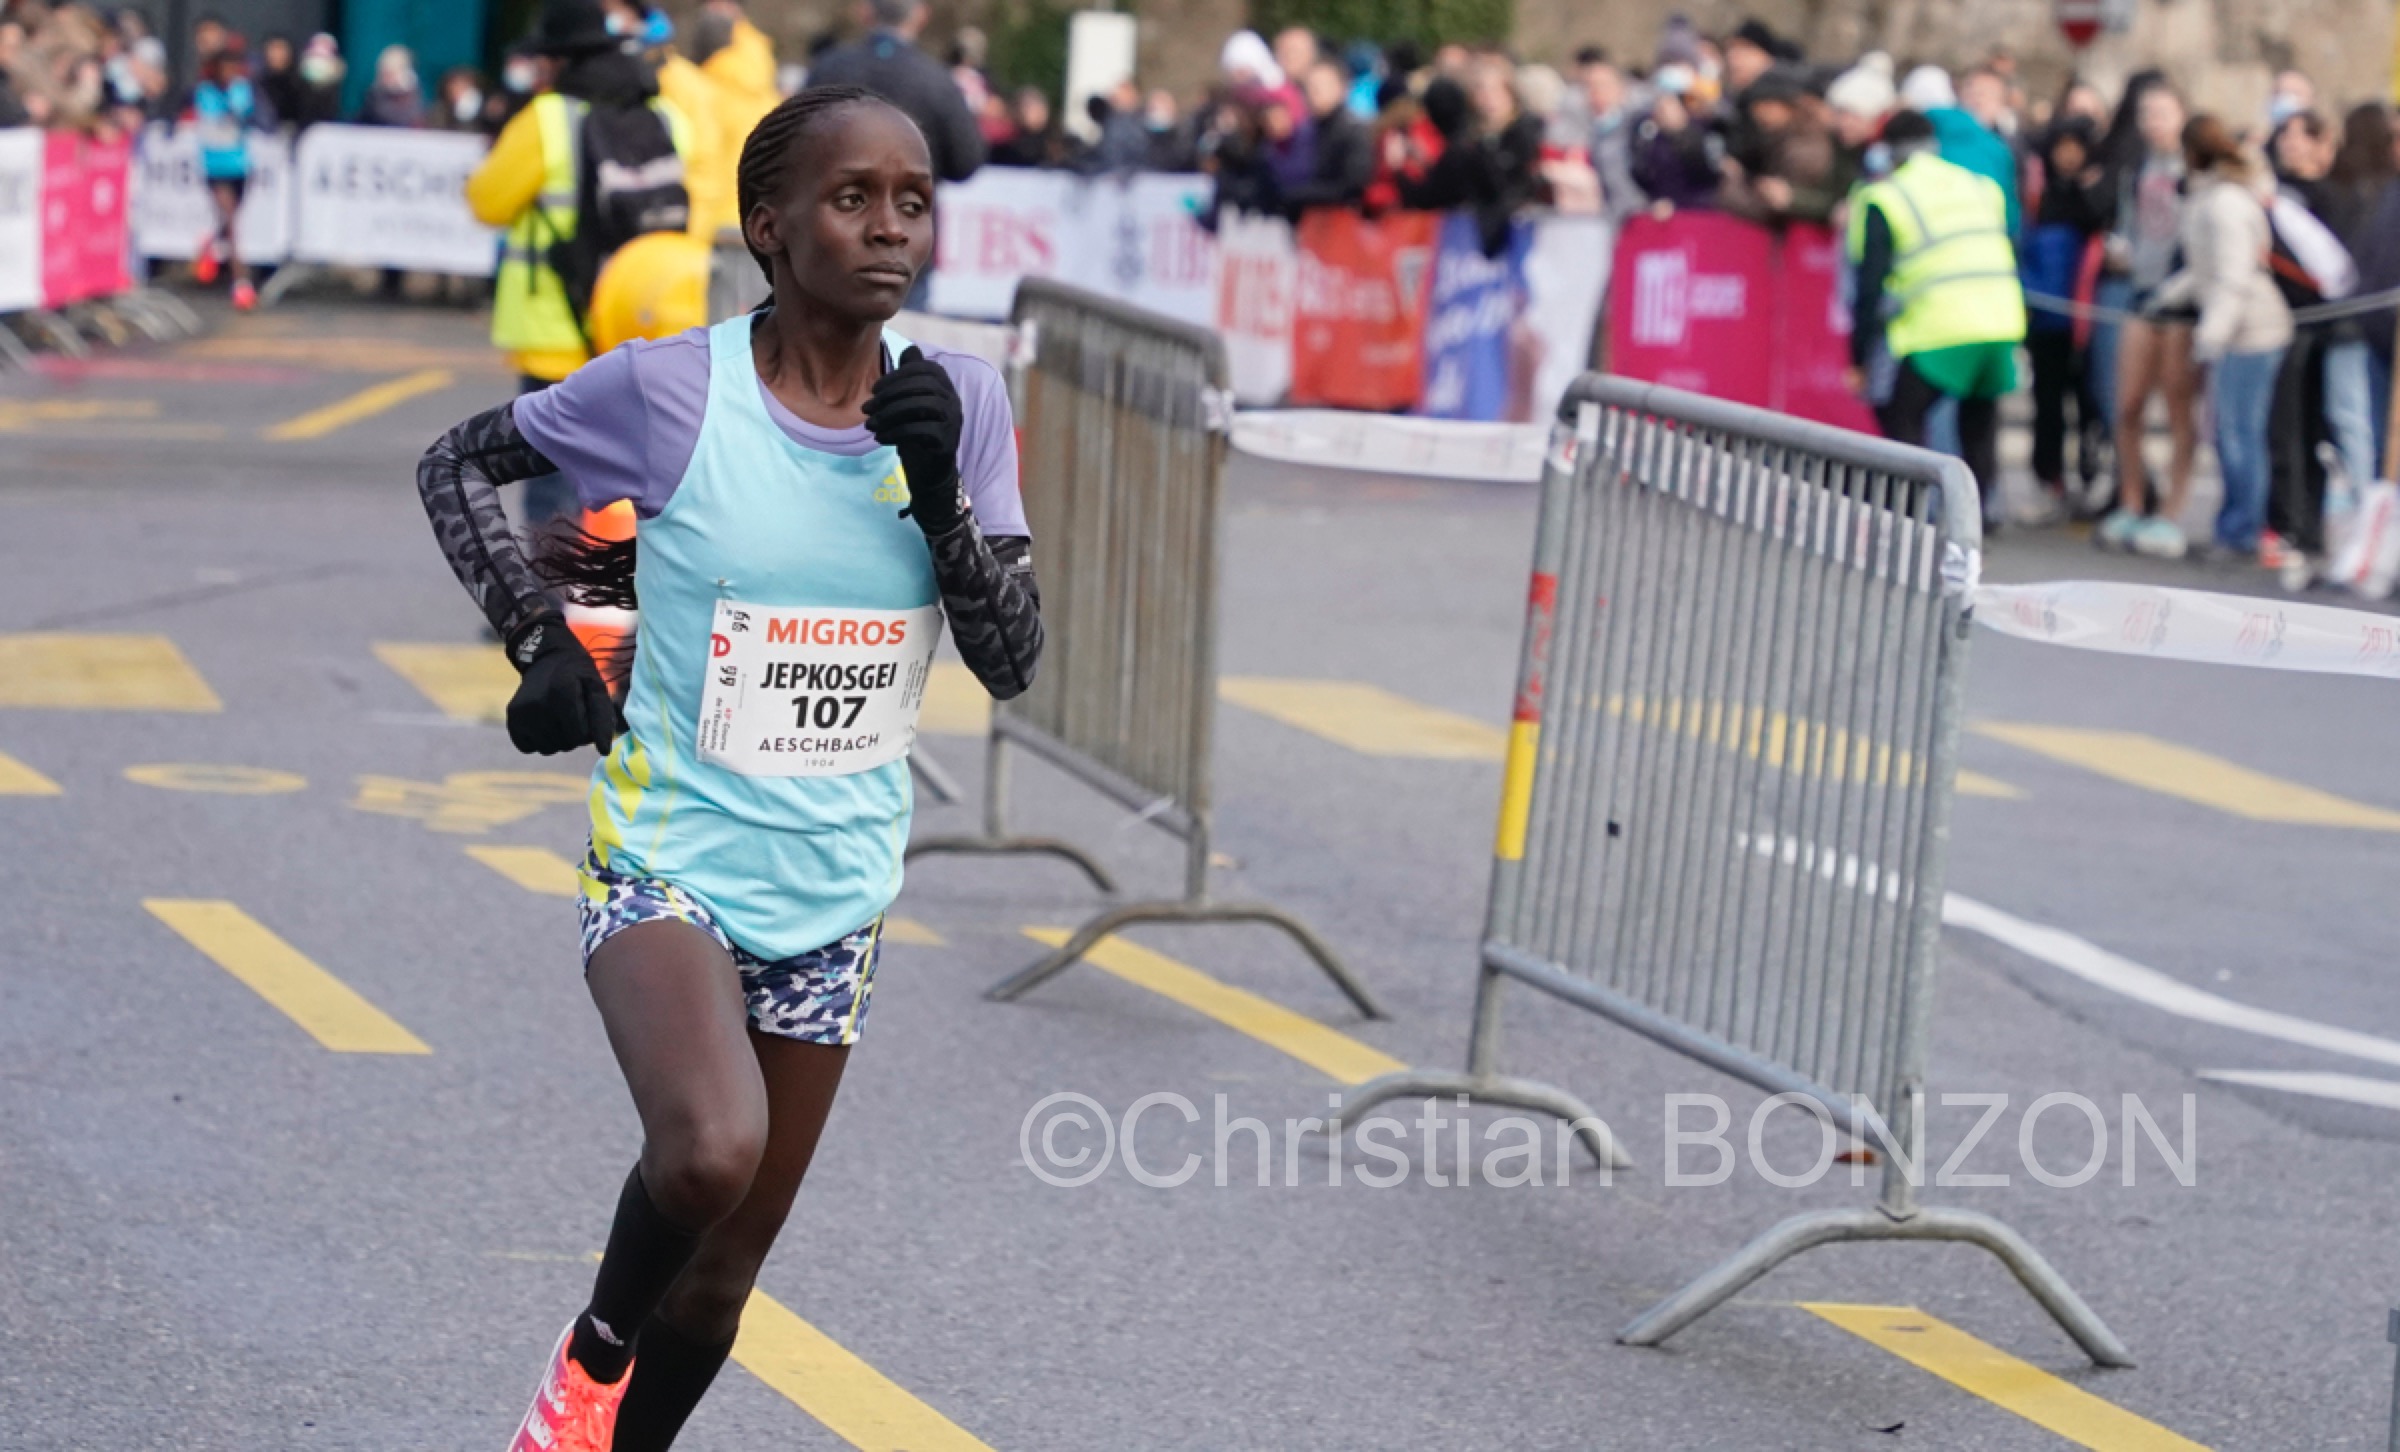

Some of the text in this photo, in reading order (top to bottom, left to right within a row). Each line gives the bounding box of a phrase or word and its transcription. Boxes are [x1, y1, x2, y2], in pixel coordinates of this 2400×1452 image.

[767, 618, 907, 646] MIGROS
[760, 662, 898, 691] JEPKOSGEI
[791, 696, 868, 729] 107
[758, 733, 880, 753] AESCHBACH
